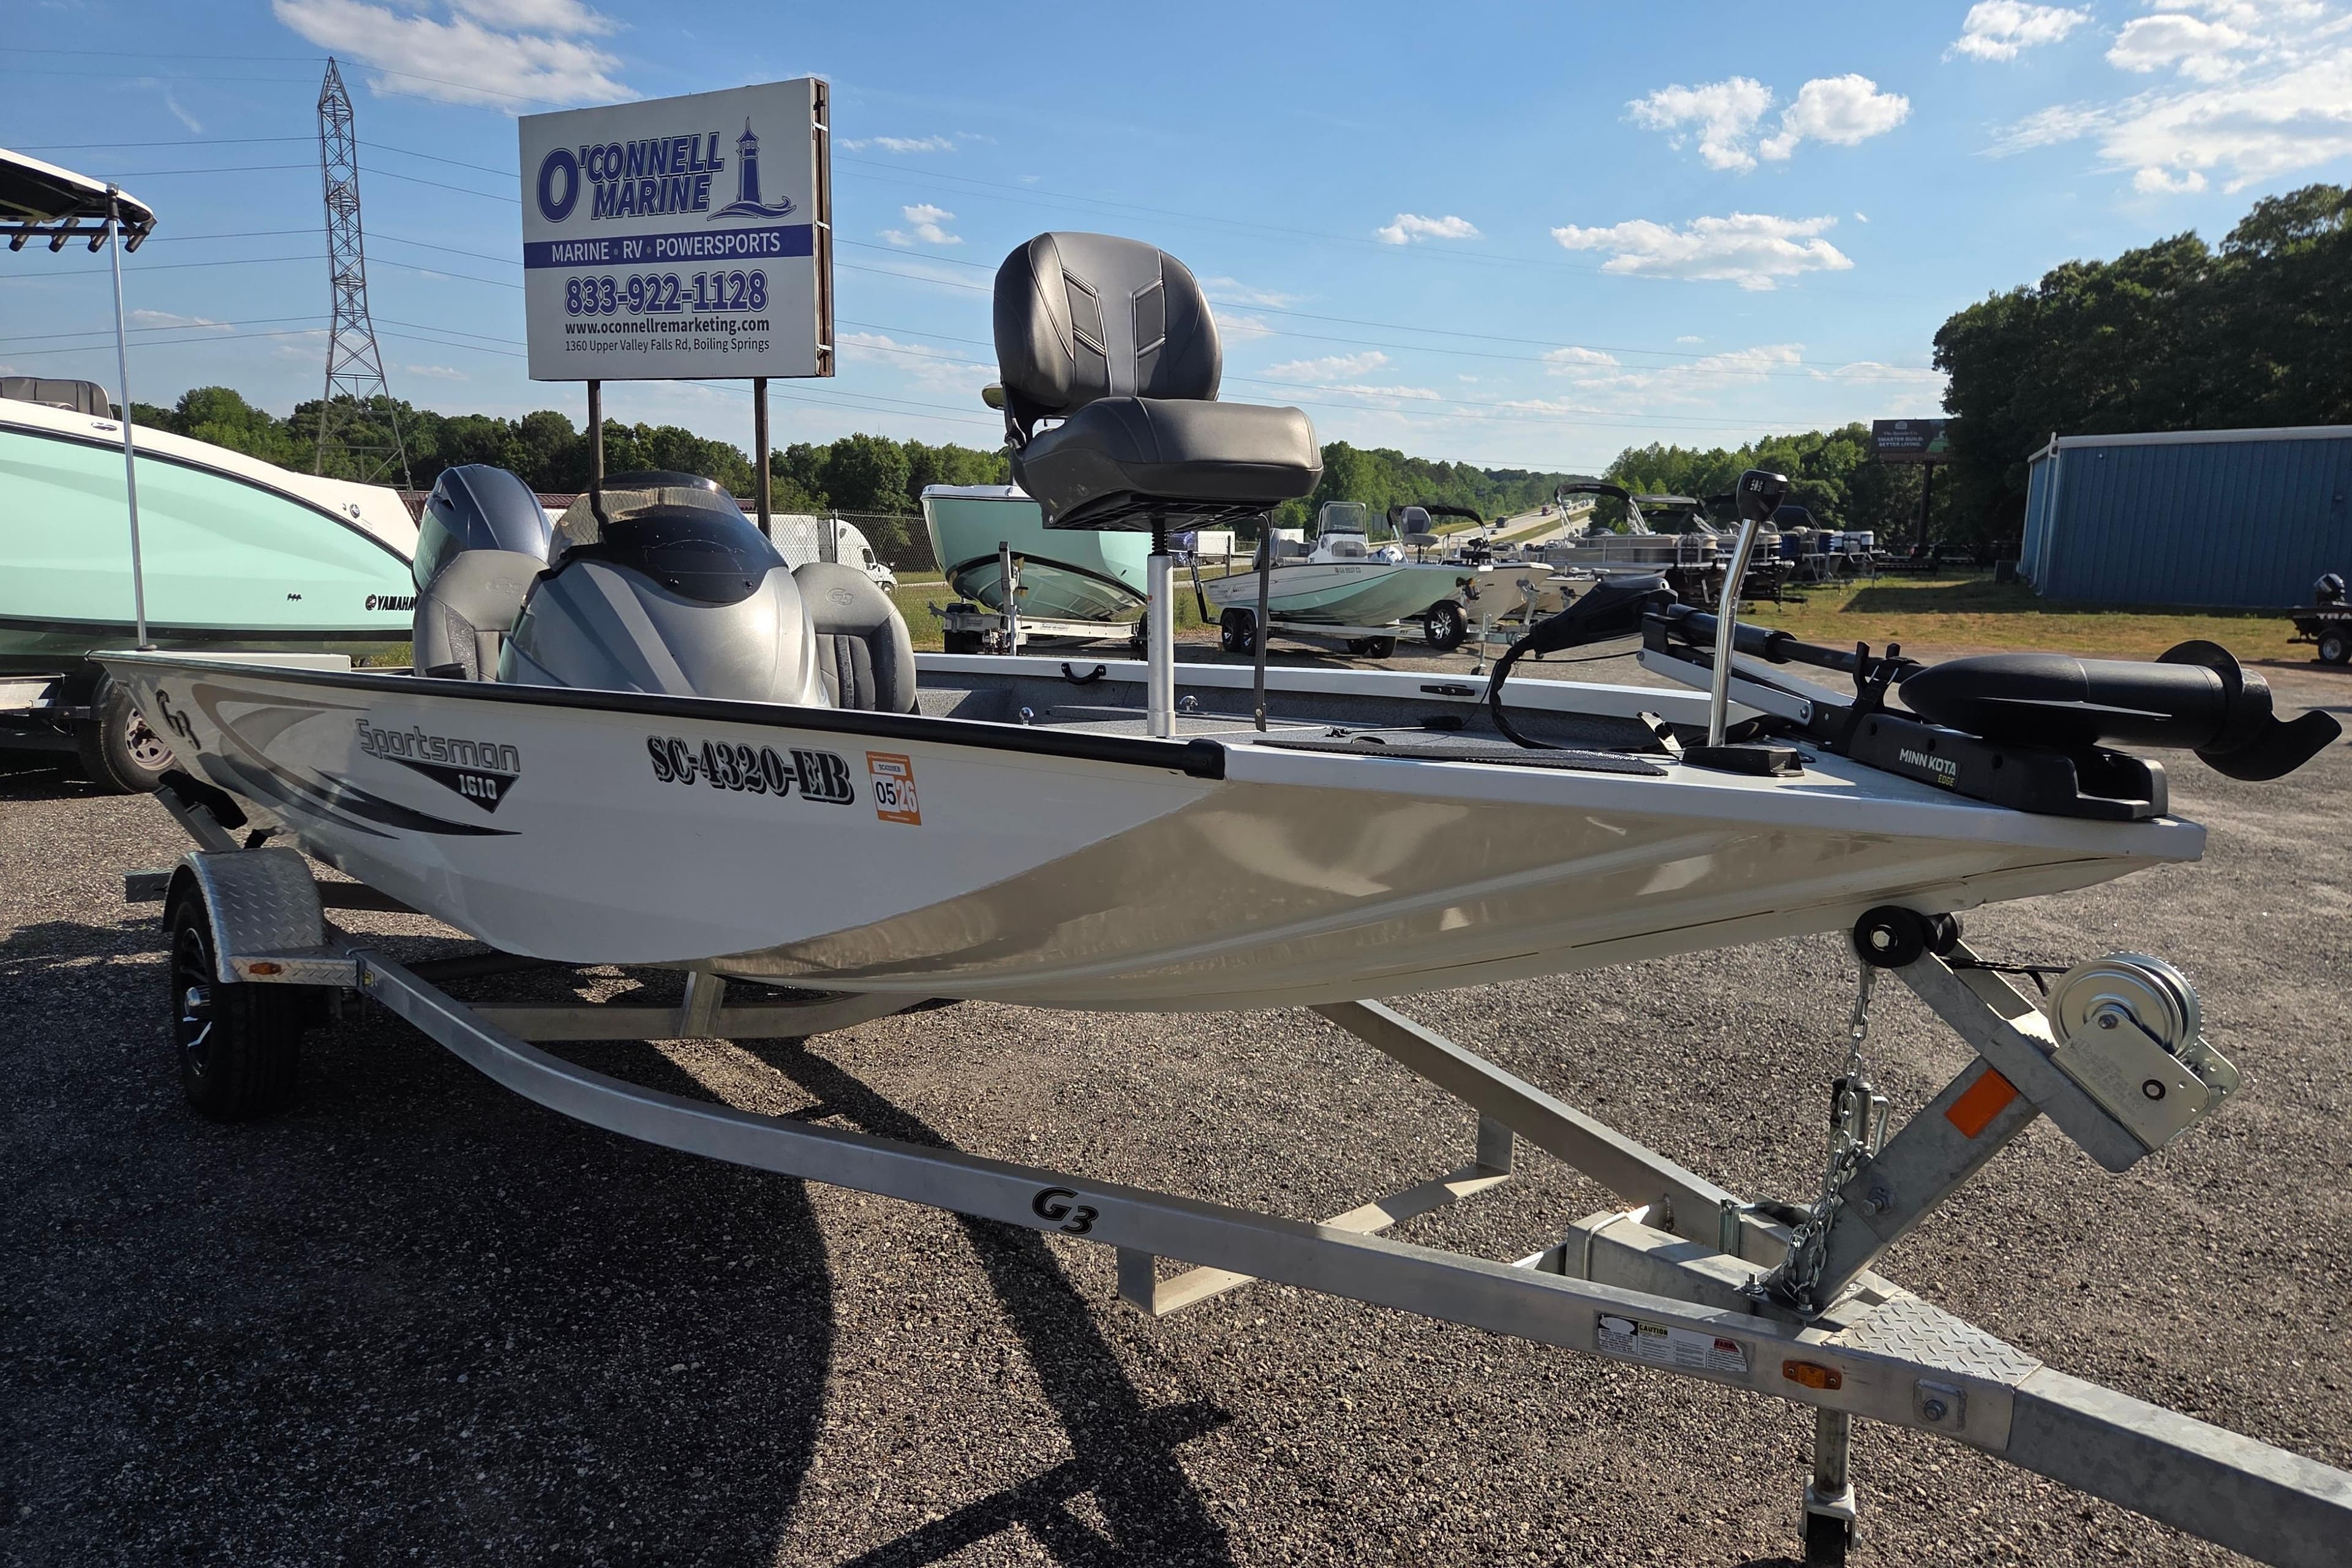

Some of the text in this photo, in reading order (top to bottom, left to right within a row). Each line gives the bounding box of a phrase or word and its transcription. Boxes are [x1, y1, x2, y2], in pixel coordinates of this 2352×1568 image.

[537, 132, 725, 222] O'CONNELL
[591, 173, 714, 221] MARINE
[552, 232, 780, 262] MARINE RV POWERSPORTS
[565, 270, 769, 317] 833-922-1128
[565, 316, 769, 335] www.oconnellremarketing.com
[565, 337, 770, 354] 1360 Upper Valley Falls Rd, Boiling Springs
[377, 595, 415, 611] YAMAHA
[355, 718, 521, 772] Sportsman
[646, 735, 855, 805] SC-4320-EB
[1899, 748, 1957, 777] MINN KOTA
[459, 774, 497, 800] 1610
[875, 778, 918, 813] 05 26
[1937, 774, 1956, 787] EDGE
[1031, 1186, 1099, 1235] G3
[1638, 1324, 1668, 1336] CAUTION
